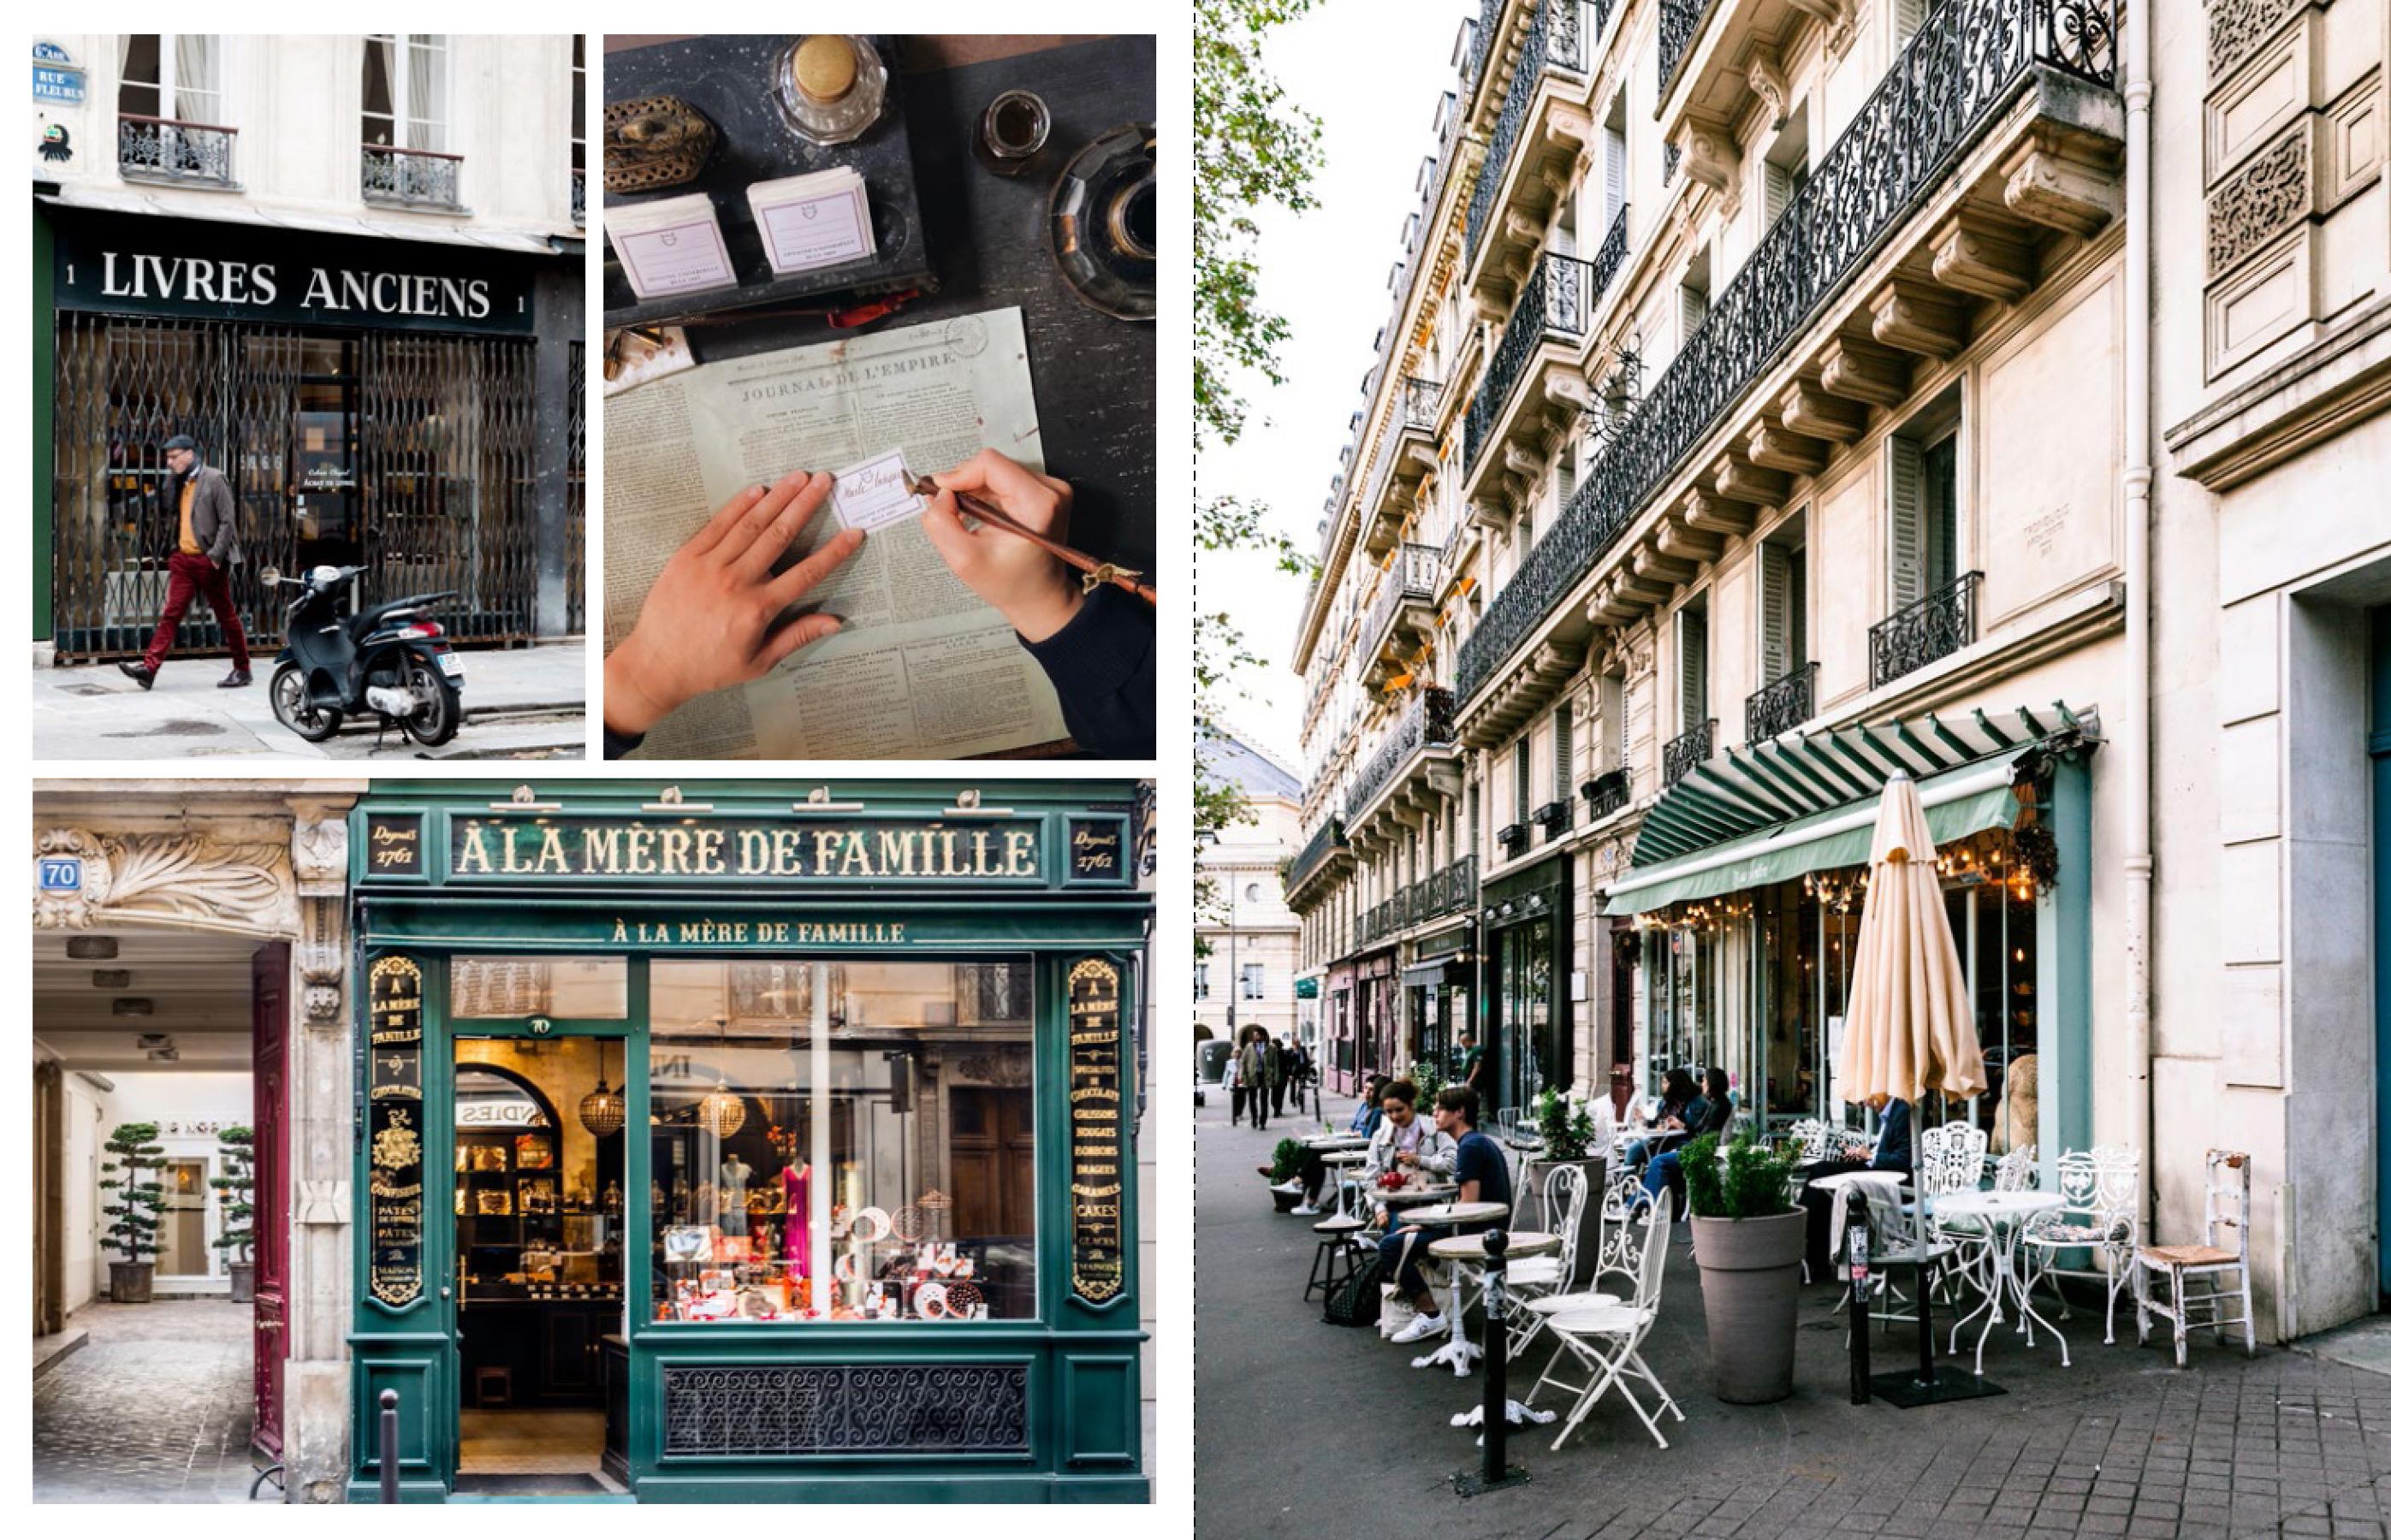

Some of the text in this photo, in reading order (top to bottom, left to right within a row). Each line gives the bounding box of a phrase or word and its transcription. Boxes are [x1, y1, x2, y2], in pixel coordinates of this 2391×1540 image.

[39, 71, 64, 84] RUE
[101, 252, 276, 305] LIVRES
[300, 267, 490, 318] ANCIENS
[742, 376, 830, 402] JOURNAL
[837, 370, 857, 386] DE
[372, 826, 418, 845] Depuis
[377, 847, 412, 868] 1761
[457, 819, 1036, 877] À LA MÈRE DE FAMILLE
[46, 864, 74, 886] 70
[611, 917, 905, 943] À LA MÈRE DE FAMILLE
[371, 1028, 422, 1045] FAMILLE
[531, 1019, 551, 1034] 70
[1071, 1029, 1118, 1045] FAMILLE
[1077, 1204, 1118, 1217] CAKES
